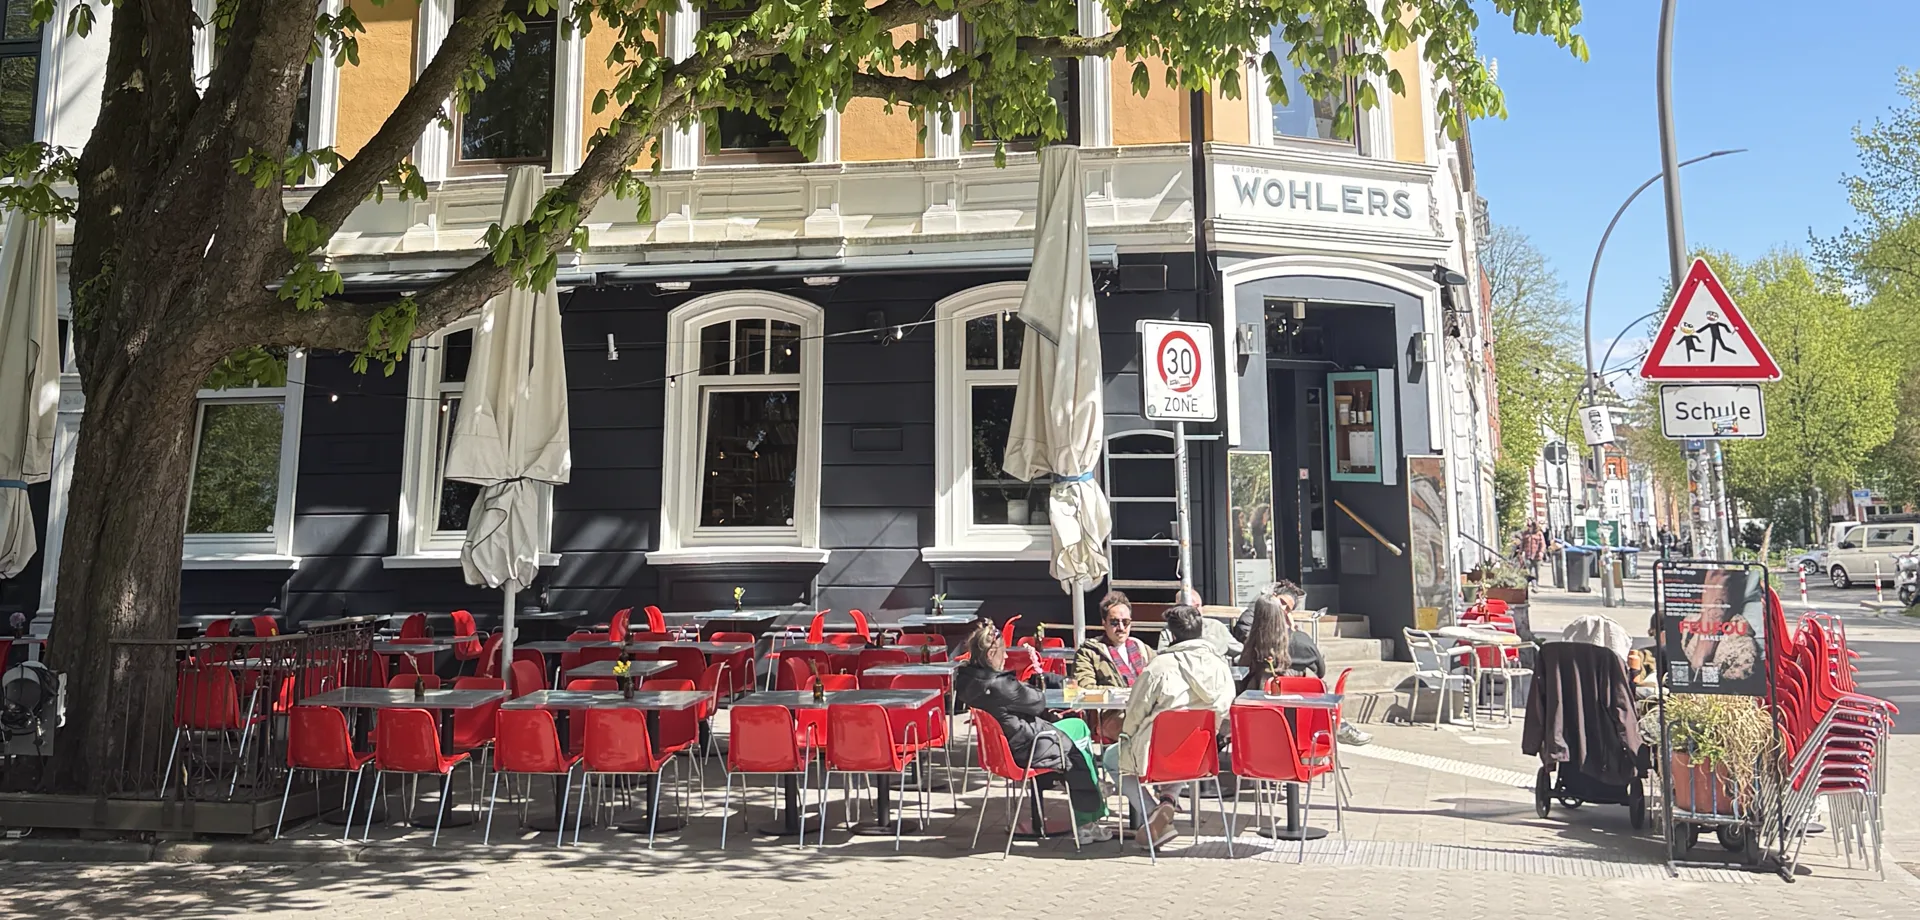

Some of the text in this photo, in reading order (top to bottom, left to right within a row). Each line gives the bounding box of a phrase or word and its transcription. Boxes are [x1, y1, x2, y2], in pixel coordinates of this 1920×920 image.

[1232, 174, 1413, 219] WOHLERS
[1166, 347, 1192, 375] 30
[1164, 396, 1199, 413] ZONE
[1675, 401, 1751, 421] Schule
